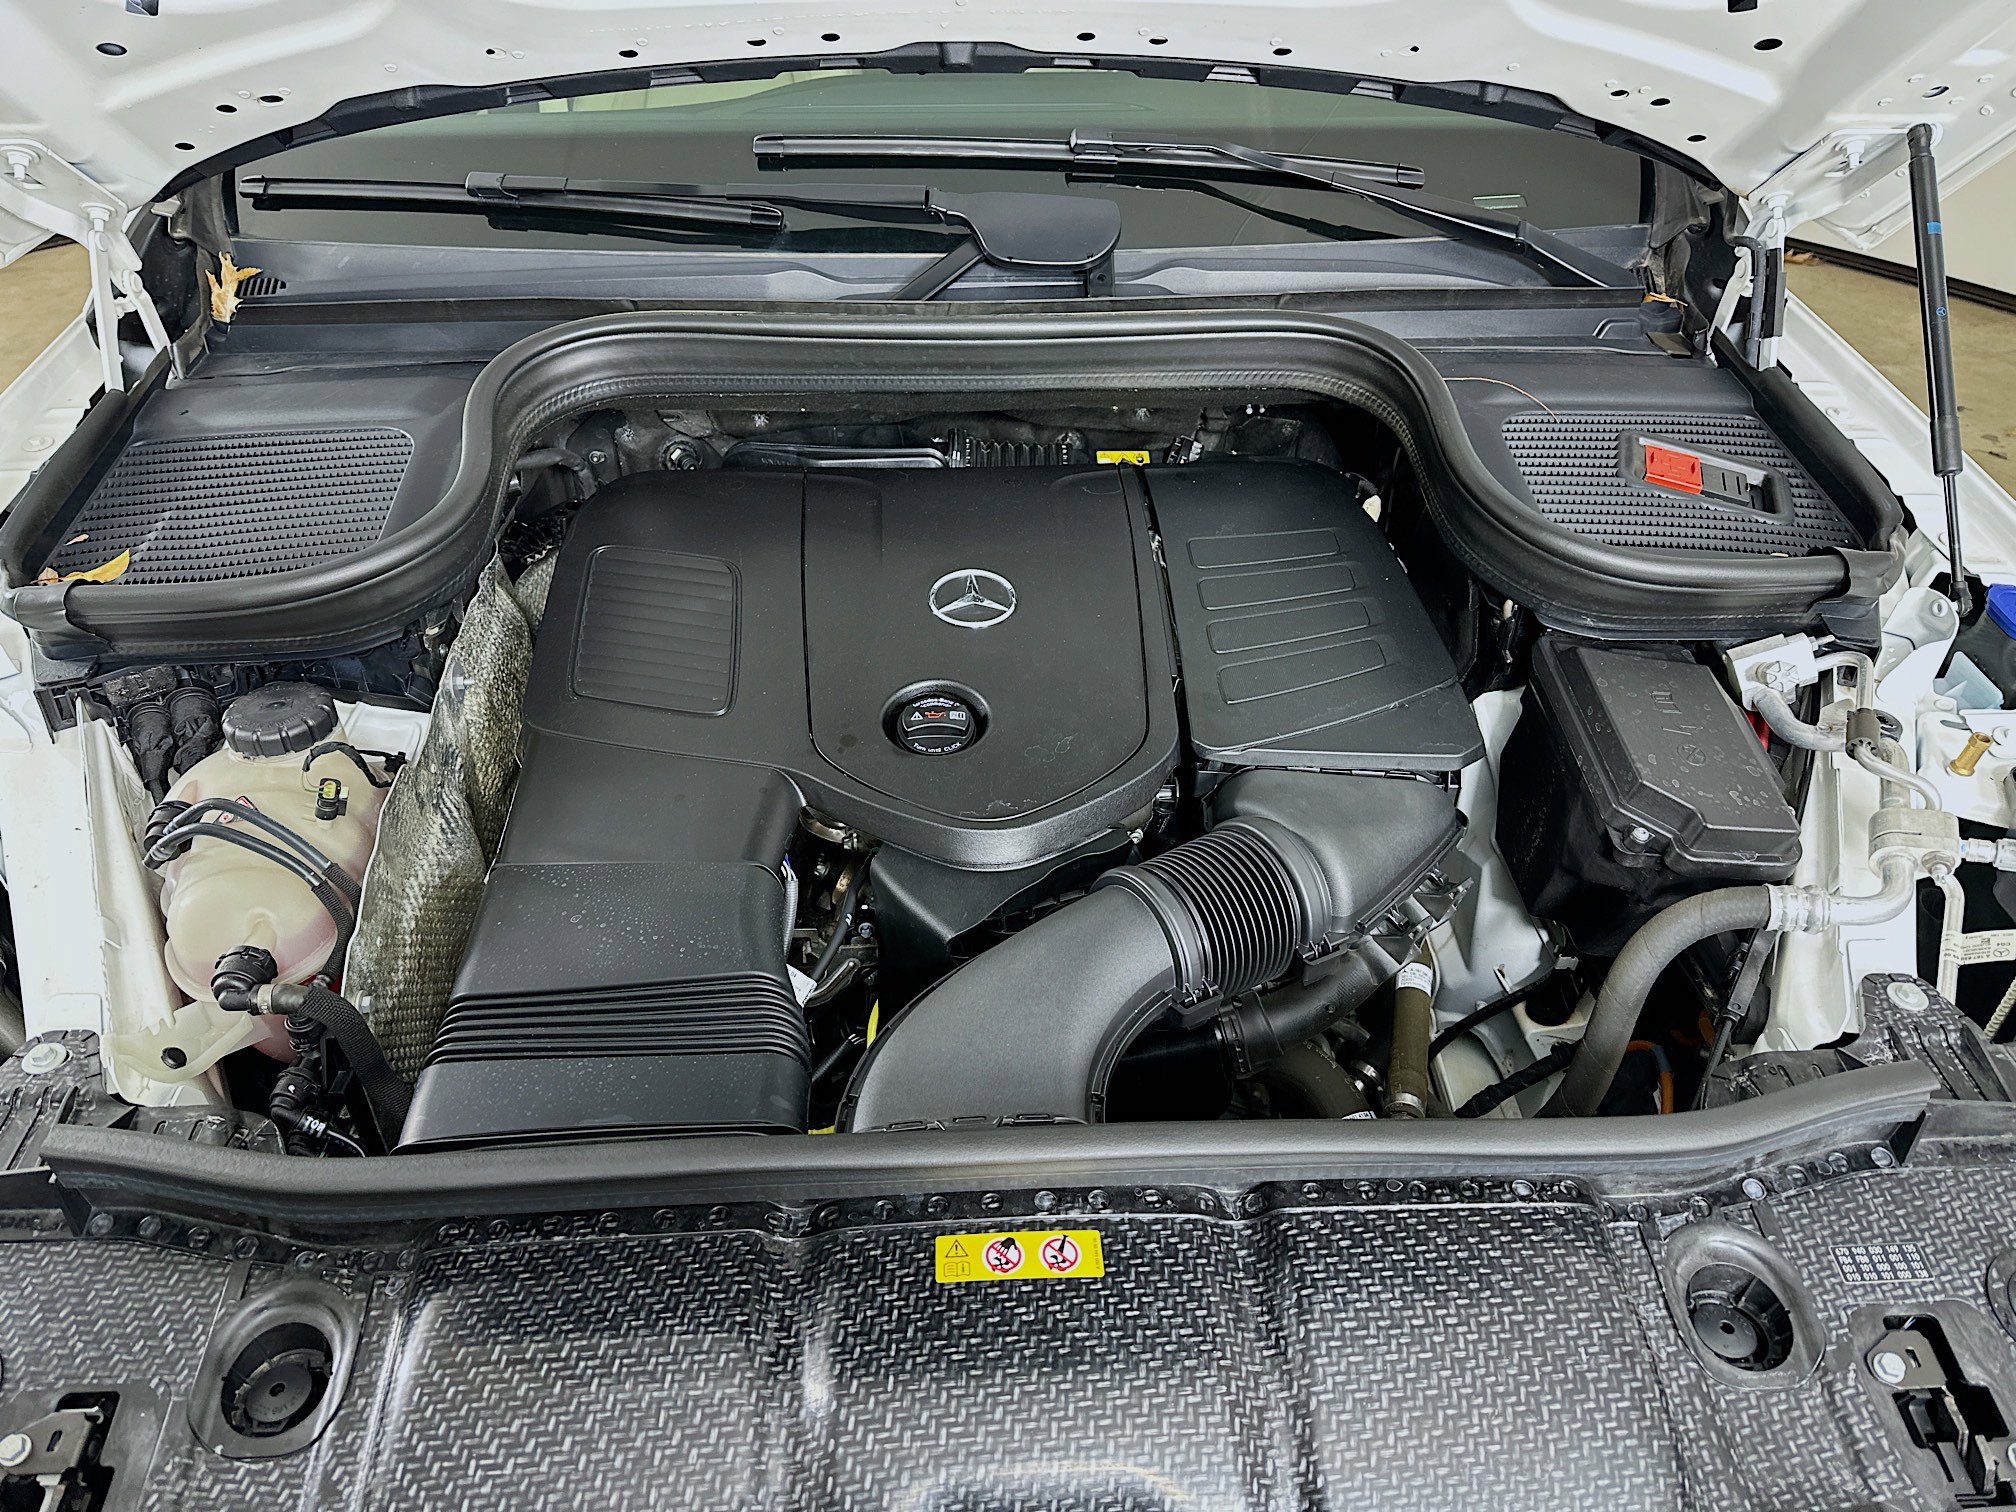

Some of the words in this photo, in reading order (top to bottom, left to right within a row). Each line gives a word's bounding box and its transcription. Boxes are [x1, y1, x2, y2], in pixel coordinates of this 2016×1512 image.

[913, 742, 927, 751] Turn
[943, 742, 962, 752] CLICK
[1872, 1254, 1887, 1263] 011
[1906, 1252, 1921, 1261] 110
